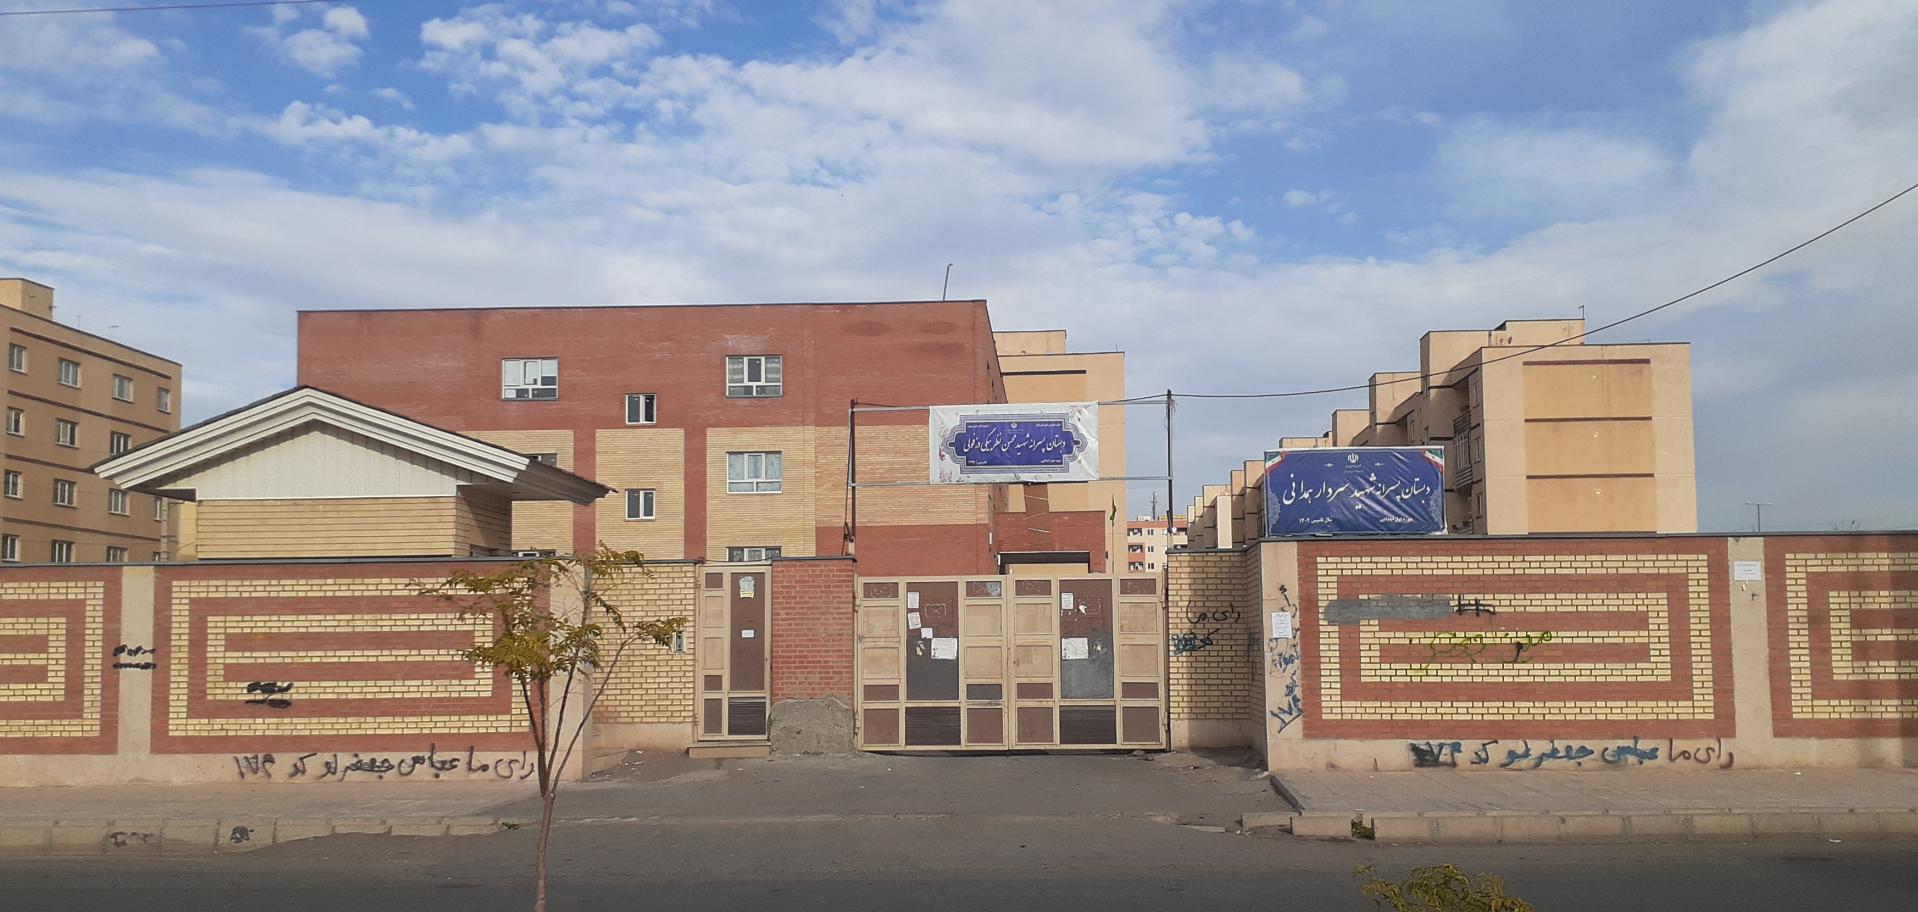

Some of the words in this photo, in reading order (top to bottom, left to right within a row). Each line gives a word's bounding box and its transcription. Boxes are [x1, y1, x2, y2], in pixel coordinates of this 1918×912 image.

[1015, 432, 1029, 455] شهید
[1028, 436, 1046, 453] پسرانه
[1046, 434, 1066, 453] دبستان
[1282, 473, 1314, 505] همدانی
[1314, 481, 1350, 503] سردار
[1350, 472, 1377, 510] شهید
[1375, 480, 1401, 502] پسرانه
[1401, 477, 1431, 504] دبستان
[399, 742, 461, 780] عباس
[467, 745, 490, 773] ما
[1668, 738, 1692, 764] ما
[1694, 737, 1734, 770] رای
[494, 750, 534, 781] رای
